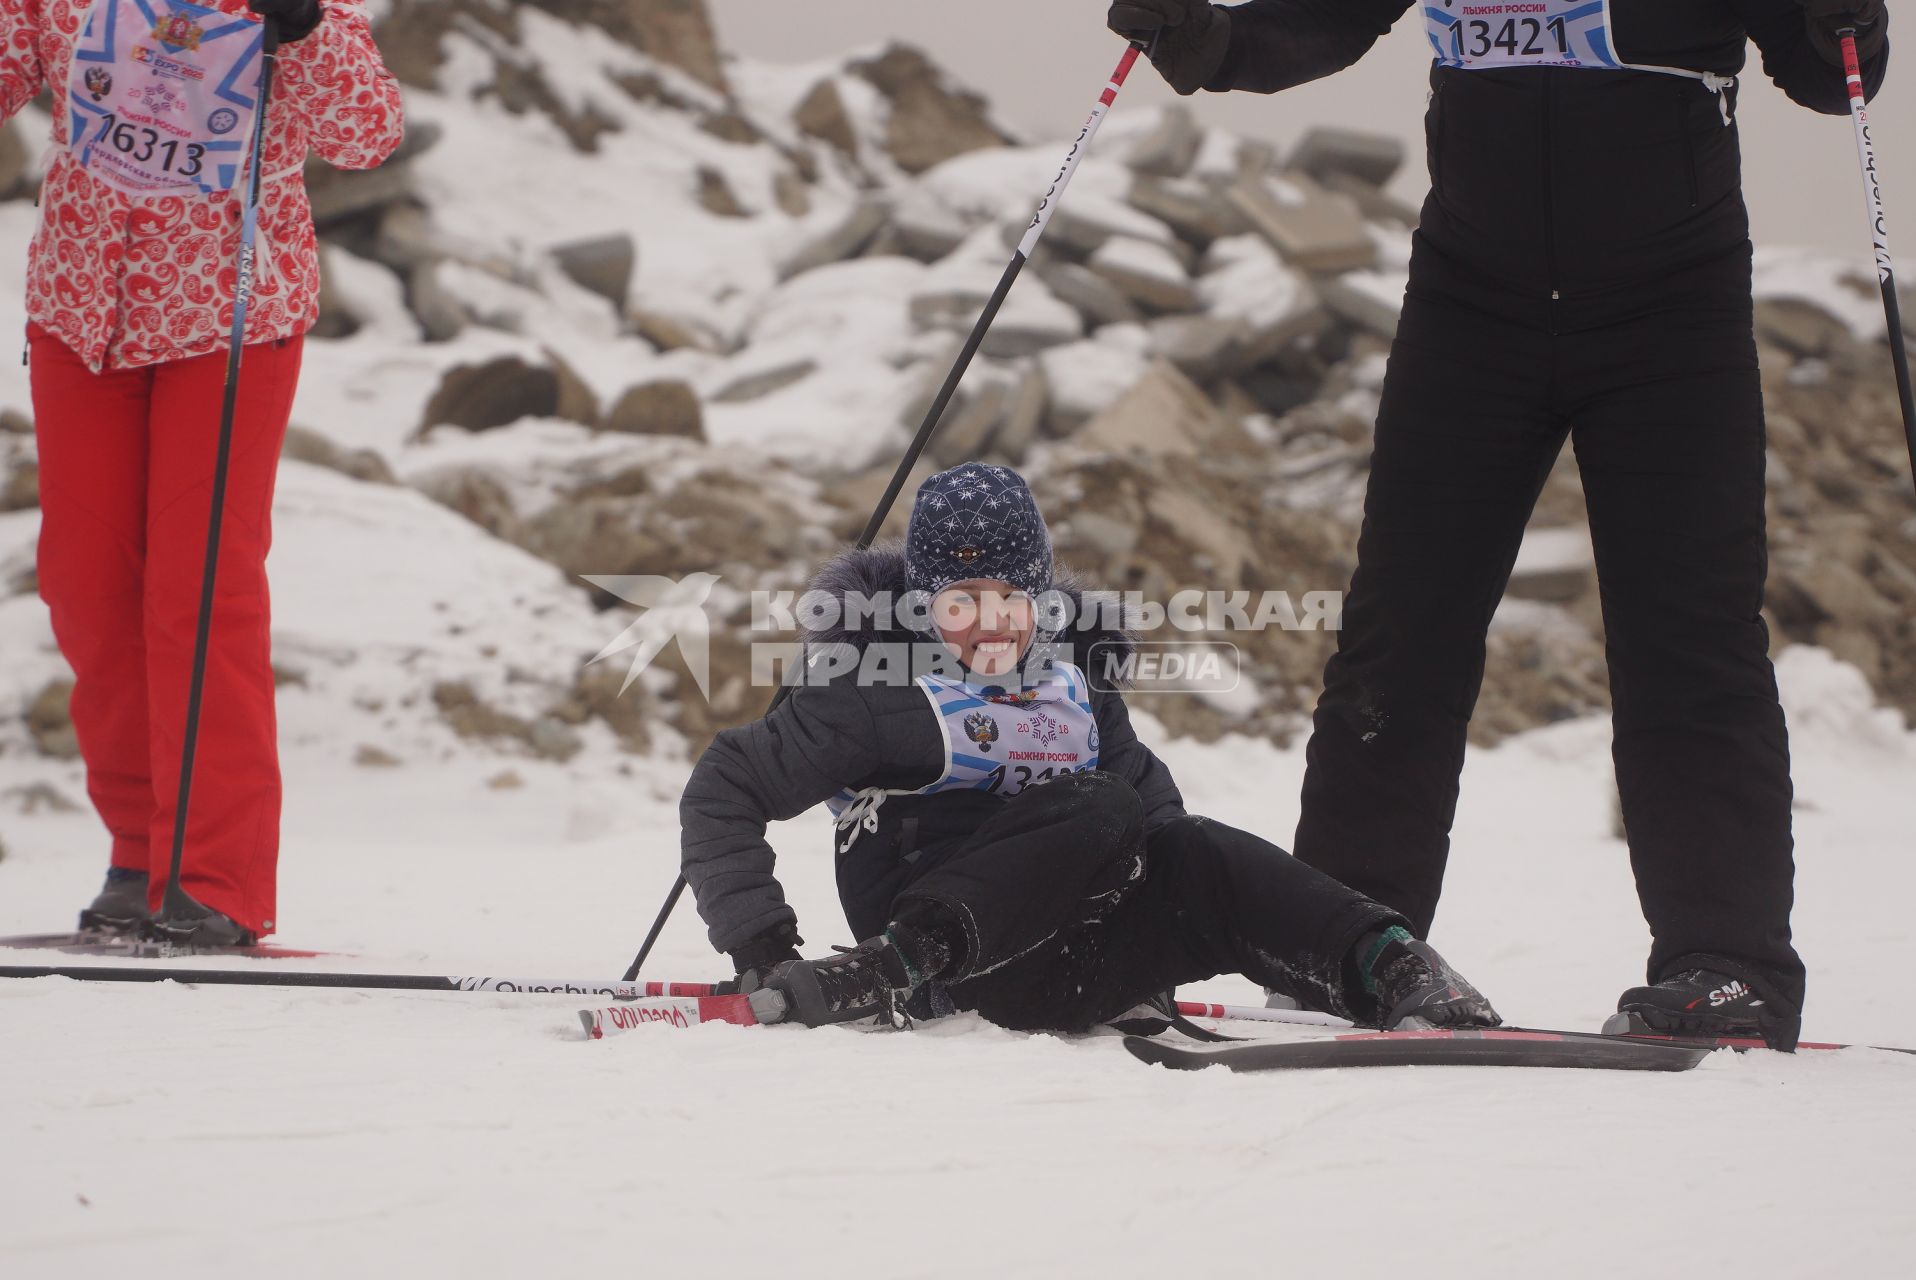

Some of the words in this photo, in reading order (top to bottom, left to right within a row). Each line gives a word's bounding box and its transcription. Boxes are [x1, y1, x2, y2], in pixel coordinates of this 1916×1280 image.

[1462, 6, 1503, 16] ЛЫЖНЯ
[1505, 3, 1547, 15] РОССИИ
[1449, 16, 1567, 57] 13421
[154, 57, 179, 73] EXPO
[153, 117, 193, 139] РОССИИ
[99, 112, 206, 177] 16313
[1016, 722, 1030, 734] 20
[1058, 724, 1069, 734] 18
[1008, 751, 1046, 761] ЛЫЖНЯ
[1047, 752, 1079, 762] РОССИИ
